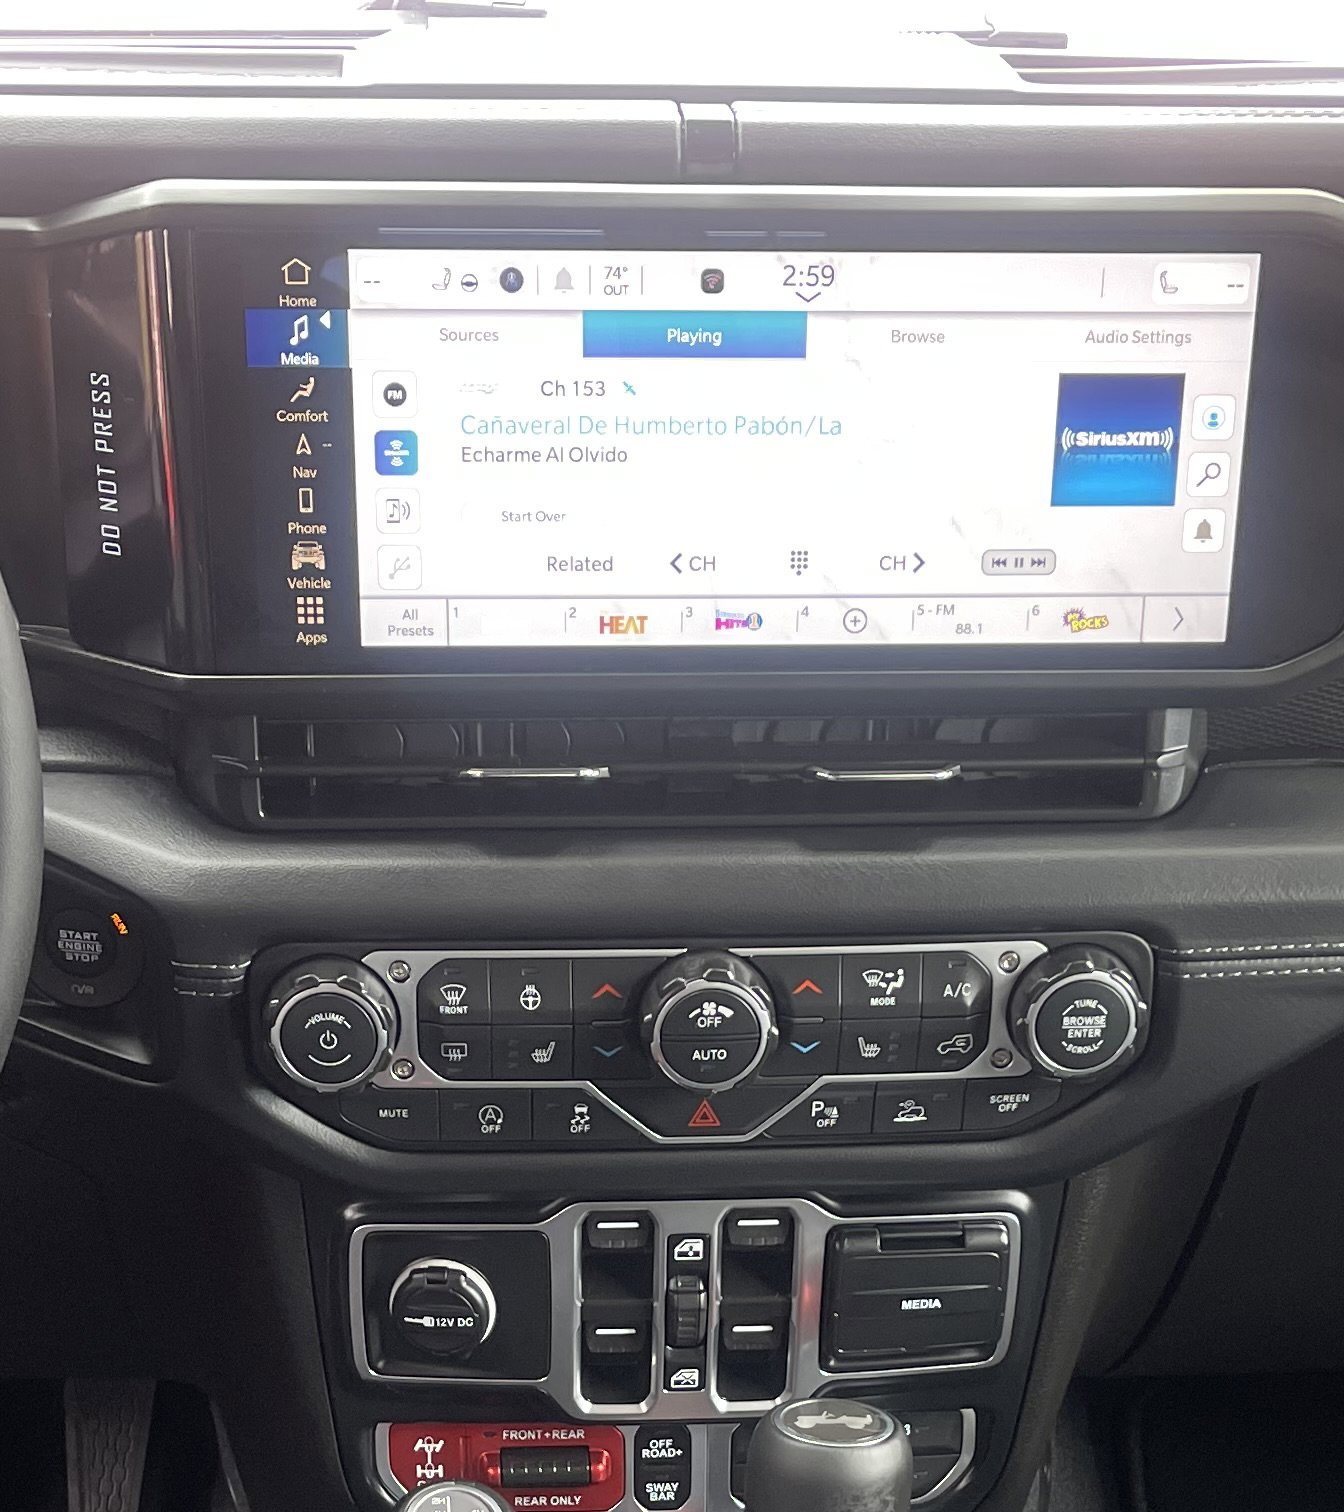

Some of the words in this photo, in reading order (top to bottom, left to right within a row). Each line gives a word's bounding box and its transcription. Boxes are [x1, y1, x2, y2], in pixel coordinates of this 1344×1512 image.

[604, 266, 628, 280] 74°
[782, 264, 835, 287] 2:59
[604, 284, 629, 295] OUT
[279, 295, 317, 307] Home
[439, 328, 499, 342] Sources
[666, 328, 723, 347] Playing
[891, 329, 946, 344] Browse
[1085, 329, 1128, 344] Audio
[1132, 329, 1192, 348] Settings
[281, 352, 319, 365] Media
[540, 380, 565, 397] Ch
[573, 380, 605, 397] 153
[90, 372, 114, 453] PRESS
[276, 410, 328, 422] Comfort
[461, 414, 571, 436] Cañaveral
[579, 415, 607, 436] De
[615, 415, 728, 436] Humberto
[735, 414, 843, 438] Pabón/La
[462, 446, 541, 463] Echarme
[569, 446, 628, 463] Olvido
[293, 466, 318, 478] Nav
[96, 464, 119, 512] NOT
[502, 510, 533, 523] Start
[535, 510, 566, 523] Over
[288, 522, 327, 534] Phone
[101, 523, 122, 556] DO
[547, 556, 614, 572] Related
[689, 556, 717, 572] CH
[879, 555, 907, 571] CH
[287, 577, 331, 589] Vehicle
[402, 609, 419, 620] All
[569, 607, 576, 618] 2
[686, 607, 693, 618] 3
[801, 606, 809, 617] 4
[917, 605, 925, 615] 5
[936, 604, 955, 615] FM
[1032, 605, 1040, 615] 6
[388, 625, 434, 637] Presets
[599, 616, 648, 634] HEAT
[955, 623, 983, 634] 88.1
[296, 632, 328, 645] Apps
[59, 929, 98, 940] START
[58, 941, 102, 953] ENGINE
[66, 952, 99, 962] STOP
[943, 983, 972, 999] A/C
[870, 997, 895, 1006] MODE
[439, 1006, 469, 1015] FRONT
[309, 1012, 345, 1025] VOLUME
[697, 1017, 722, 1028] OFF
[1063, 1015, 1106, 1026] BROWSE
[1068, 1029, 1101, 1038] ENTER
[1066, 1043, 1099, 1054] SCROLL
[692, 1049, 727, 1061] AUTO
[989, 1093, 1030, 1104] SCREEN
[379, 1109, 409, 1118] MUTE
[998, 1103, 1018, 1113] OFF
[570, 1124, 590, 1133] OFF
[817, 1118, 837, 1128] OFF
[481, 1125, 501, 1134] OFF
[901, 1298, 942, 1310] MEDIA
[436, 1317, 455, 1327] 12V
[457, 1317, 474, 1327] DC
[649, 1439, 673, 1449] OFF
[641, 1448, 683, 1458] ROAD+
[645, 1482, 679, 1493] SWAY
[514, 1497, 547, 1506] REAR
[550, 1496, 581, 1506] ONLY
[649, 1492, 675, 1501] BAR
